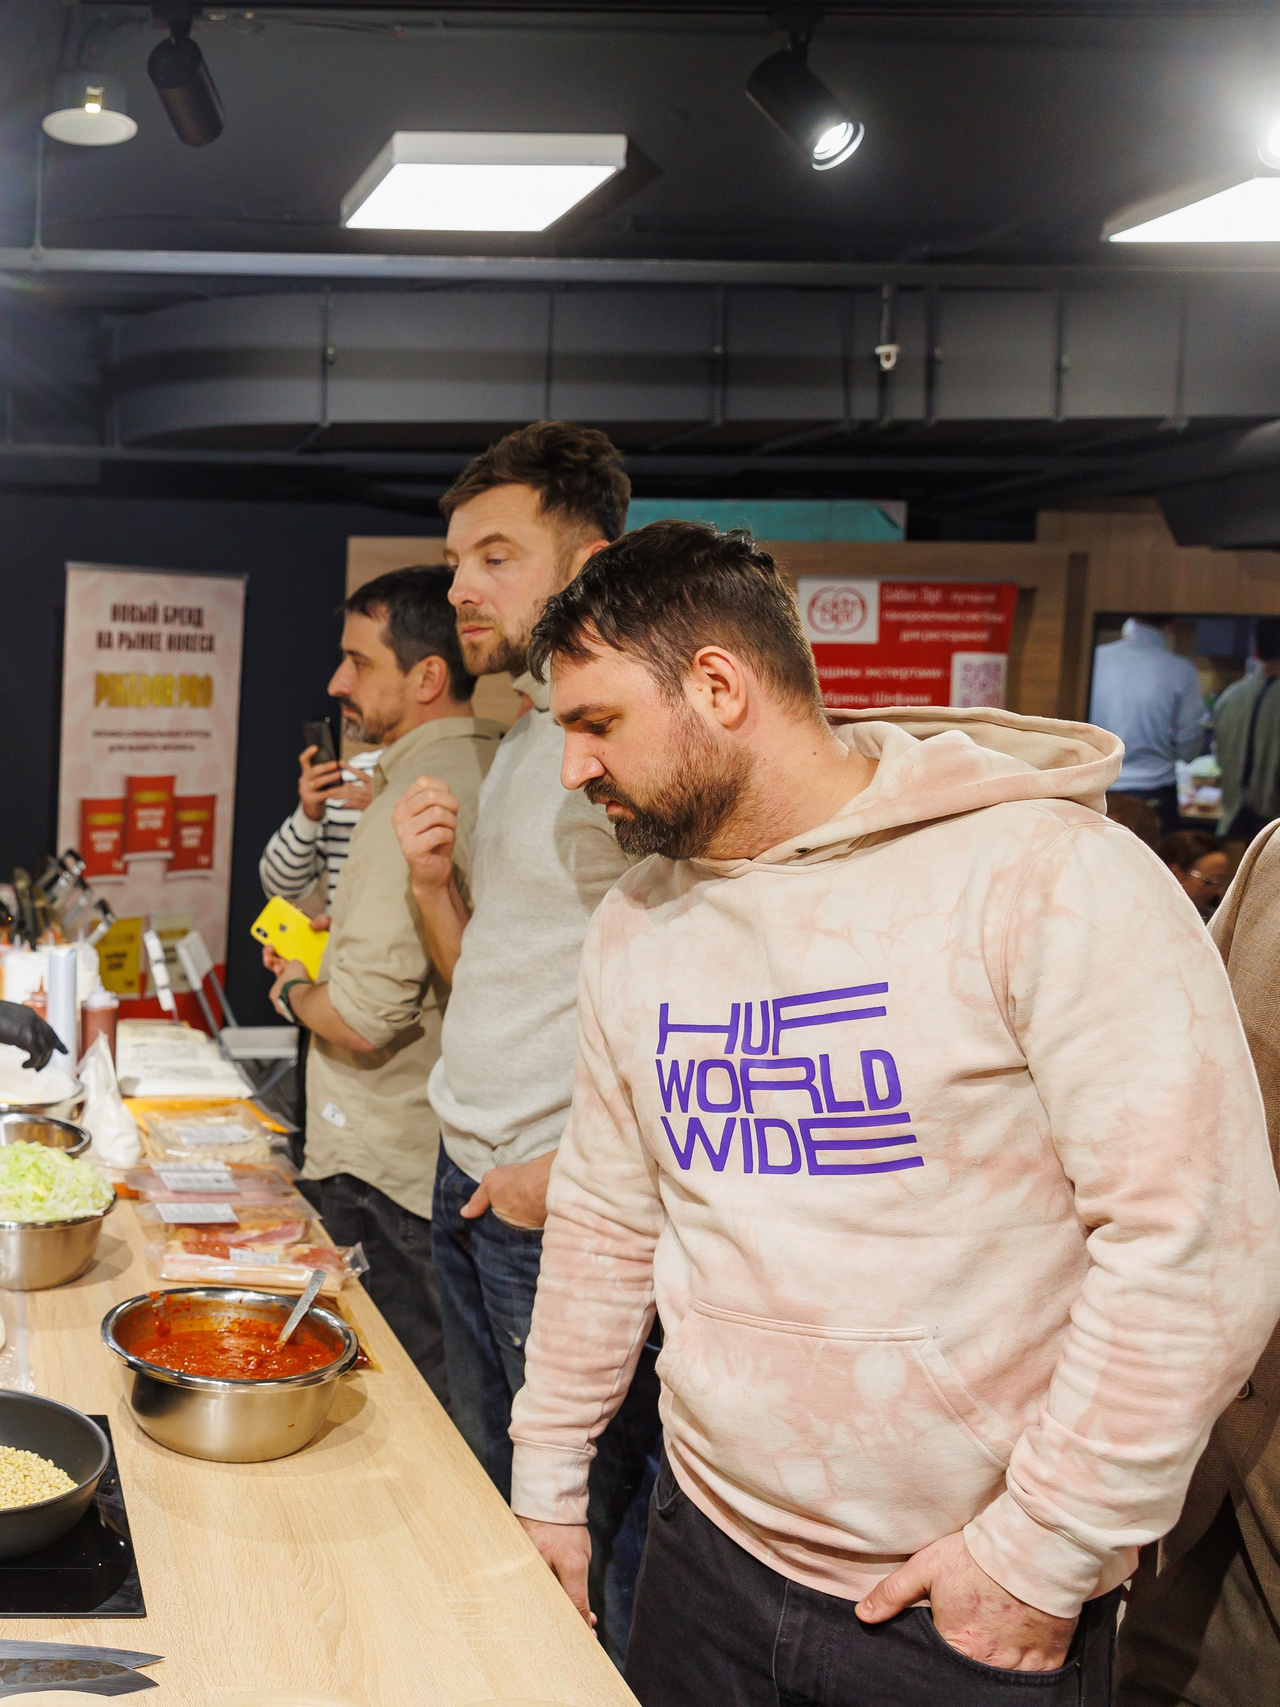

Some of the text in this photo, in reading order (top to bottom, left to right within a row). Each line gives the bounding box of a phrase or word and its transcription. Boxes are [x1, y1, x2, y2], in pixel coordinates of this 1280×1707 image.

[656, 982, 889, 1056] HUF
[656, 1049, 902, 1114] WORLD
[661, 1111, 924, 1176] WIDE
